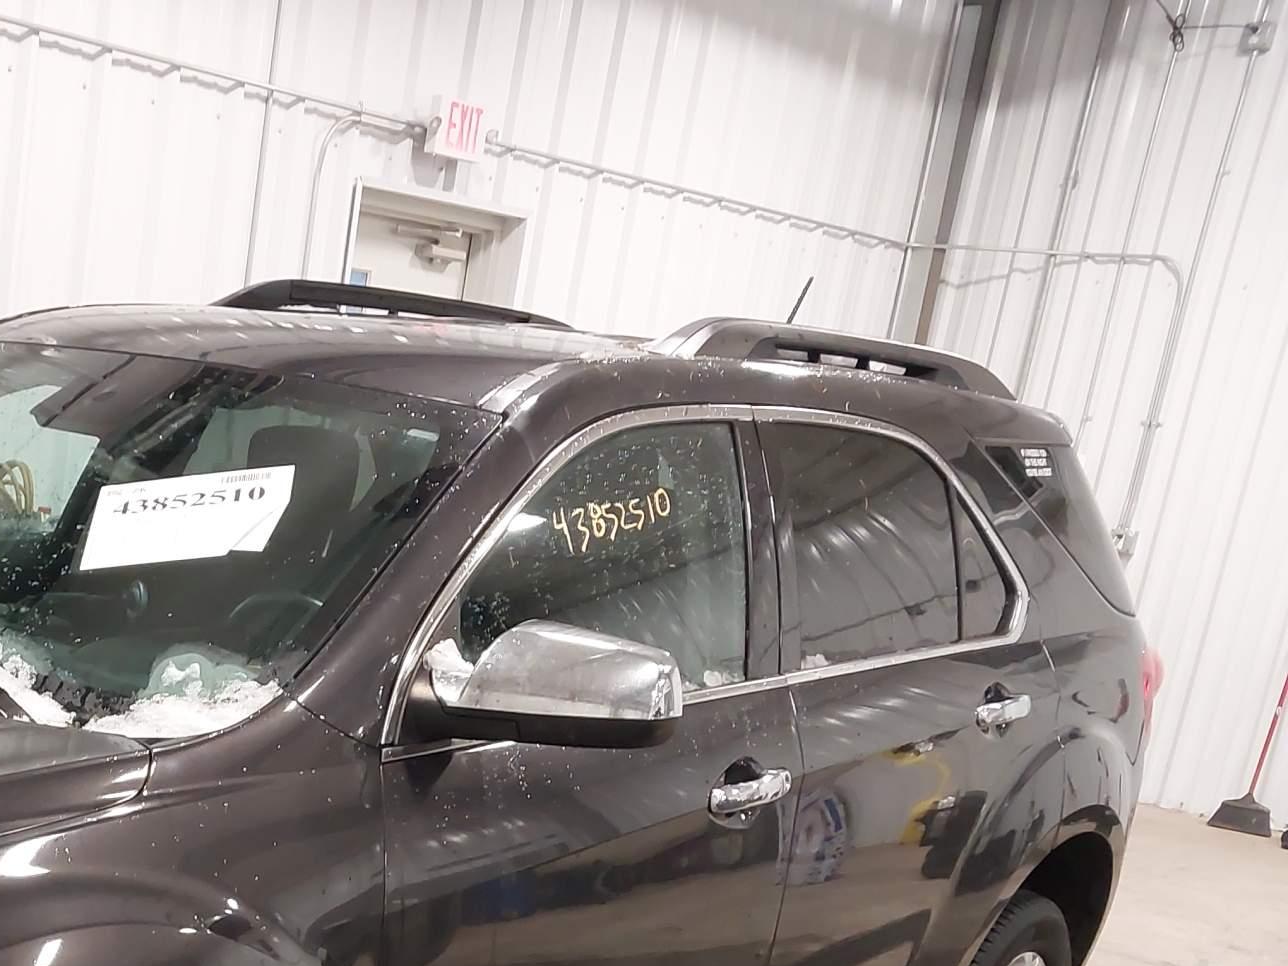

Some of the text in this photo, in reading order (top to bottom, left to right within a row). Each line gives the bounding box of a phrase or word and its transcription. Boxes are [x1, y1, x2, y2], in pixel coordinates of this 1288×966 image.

[445, 101, 484, 153] EXIT
[113, 486, 266, 515] 43852510
[553, 487, 671, 556] 43852510
